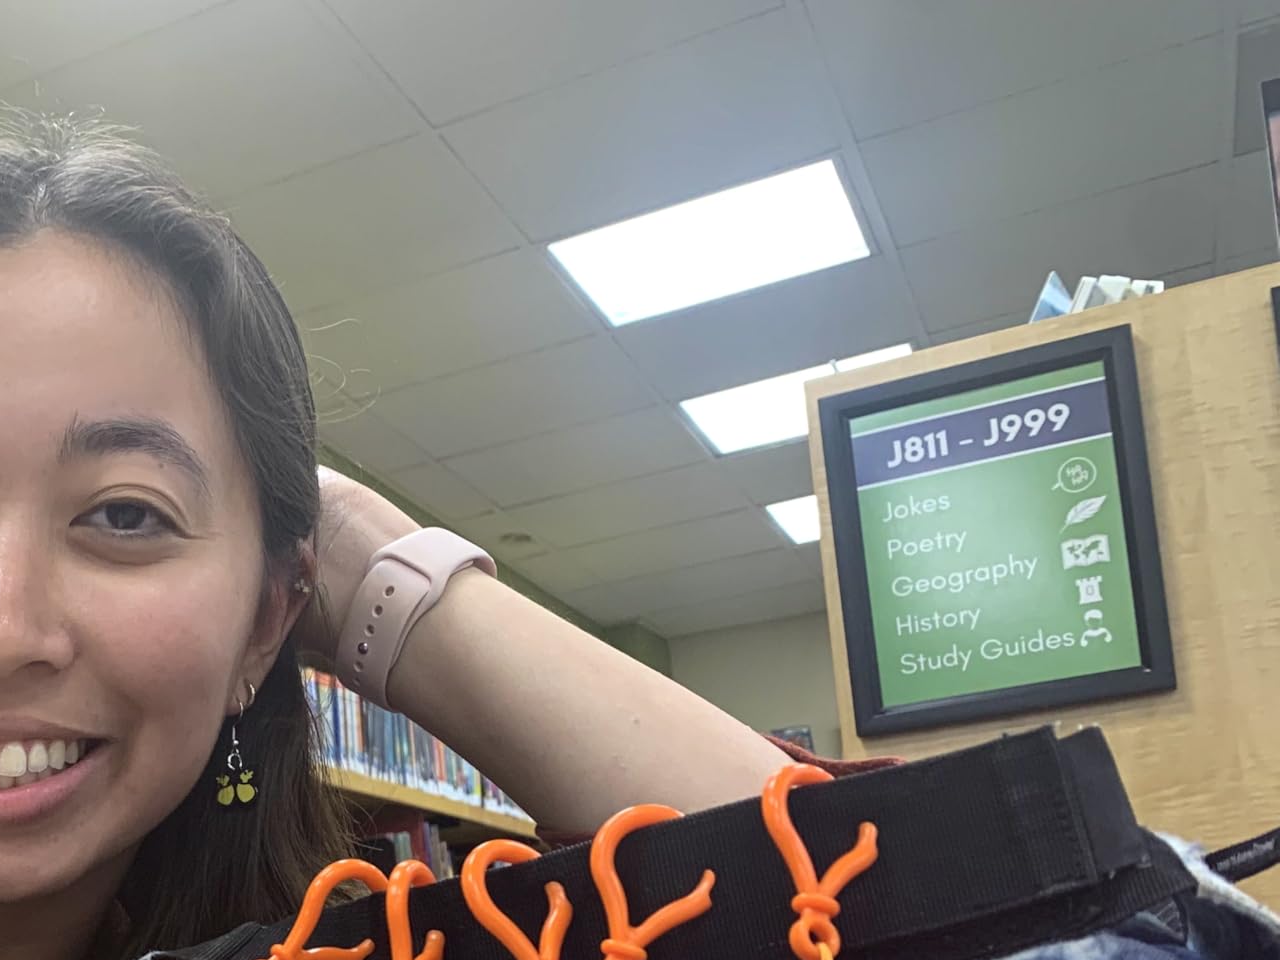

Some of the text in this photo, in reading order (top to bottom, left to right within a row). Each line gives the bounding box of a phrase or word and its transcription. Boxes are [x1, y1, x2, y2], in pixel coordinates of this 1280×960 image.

[887, 429, 950, 469] J811
[983, 402, 1071, 448] J999
[882, 494, 951, 524] Jokes
[887, 529, 968, 560] Poetry
[892, 555, 1039, 598] Geography
[896, 606, 981, 637] History
[900, 630, 1076, 675] Study Guides
